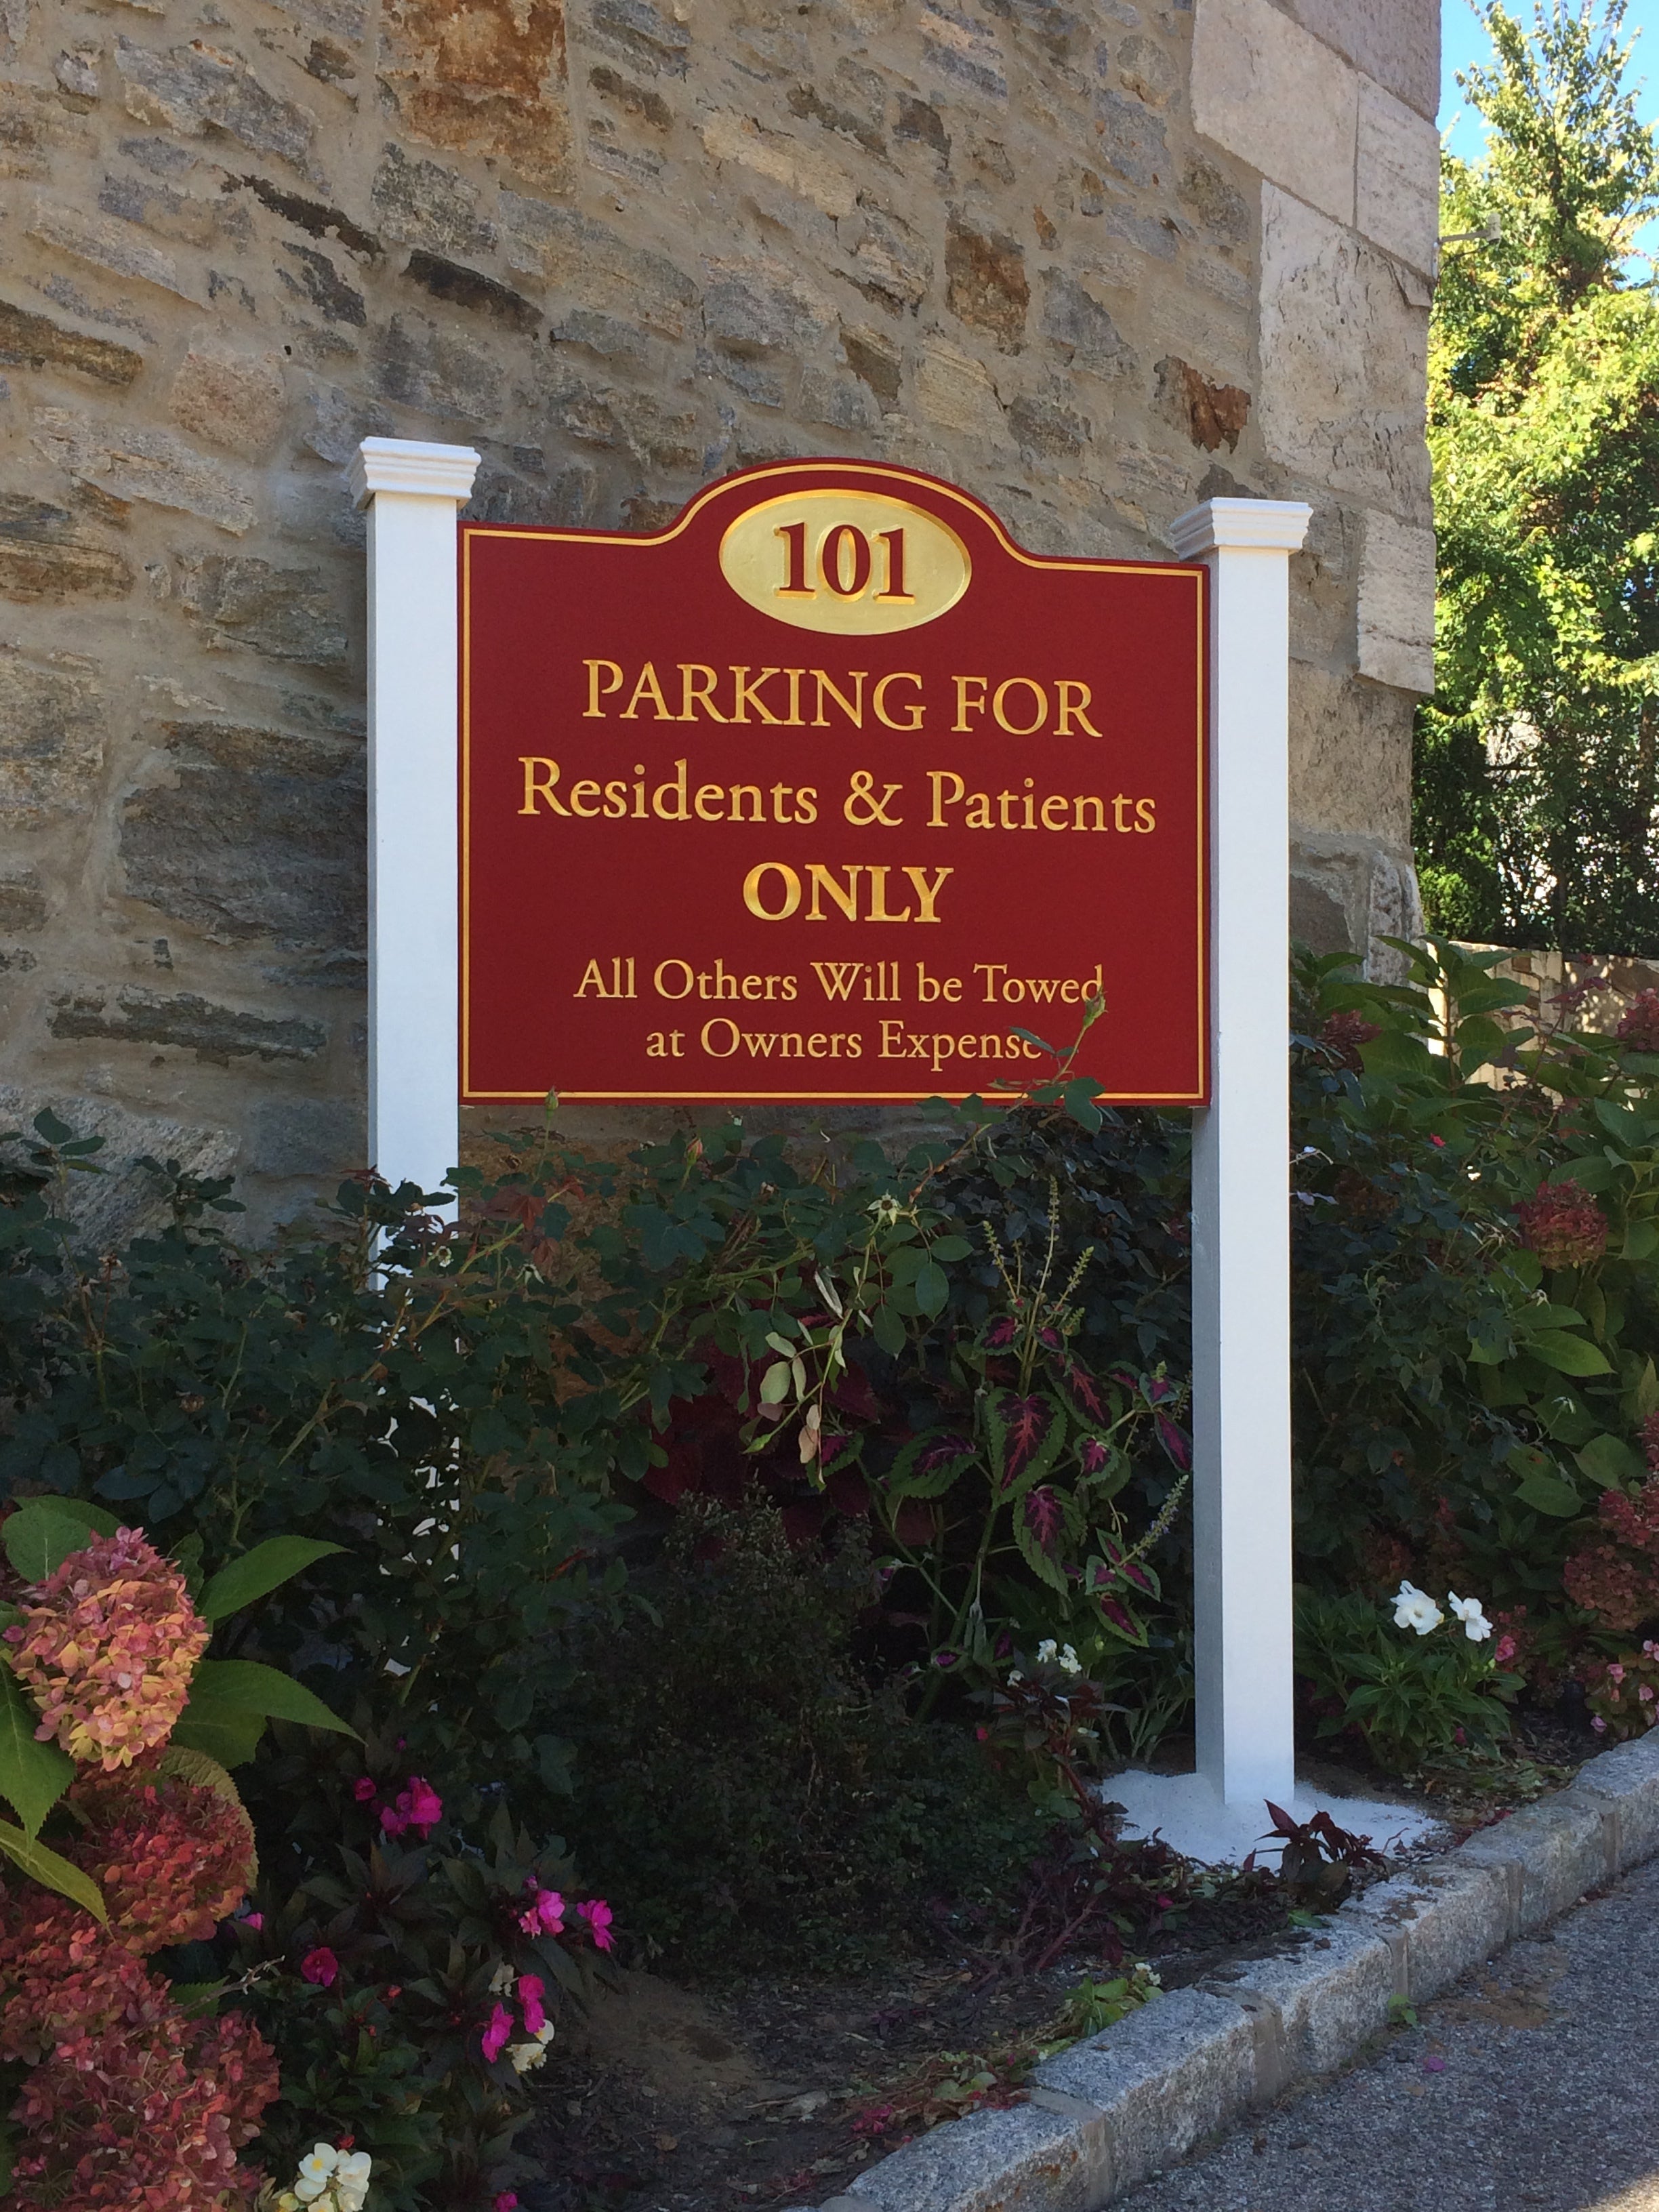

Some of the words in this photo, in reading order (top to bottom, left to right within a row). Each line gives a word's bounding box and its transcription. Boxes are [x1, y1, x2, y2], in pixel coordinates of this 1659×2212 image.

[774, 521, 916, 605] 101
[582, 659, 926, 731] PARKING
[950, 676, 1103, 738] FOR
[517, 756, 817, 824] Residents
[843, 770, 903, 827] &
[926, 771, 1155, 834] Patients
[743, 862, 954, 923] ONLY
[573, 957, 638, 998] All
[653, 958, 798, 1000] Others
[810, 960, 902, 1002] Will
[916, 962, 962, 1002] be
[972, 963, 1103, 1004] Towed
[647, 1029, 686, 1057] at
[701, 1017, 862, 1058] Owners
